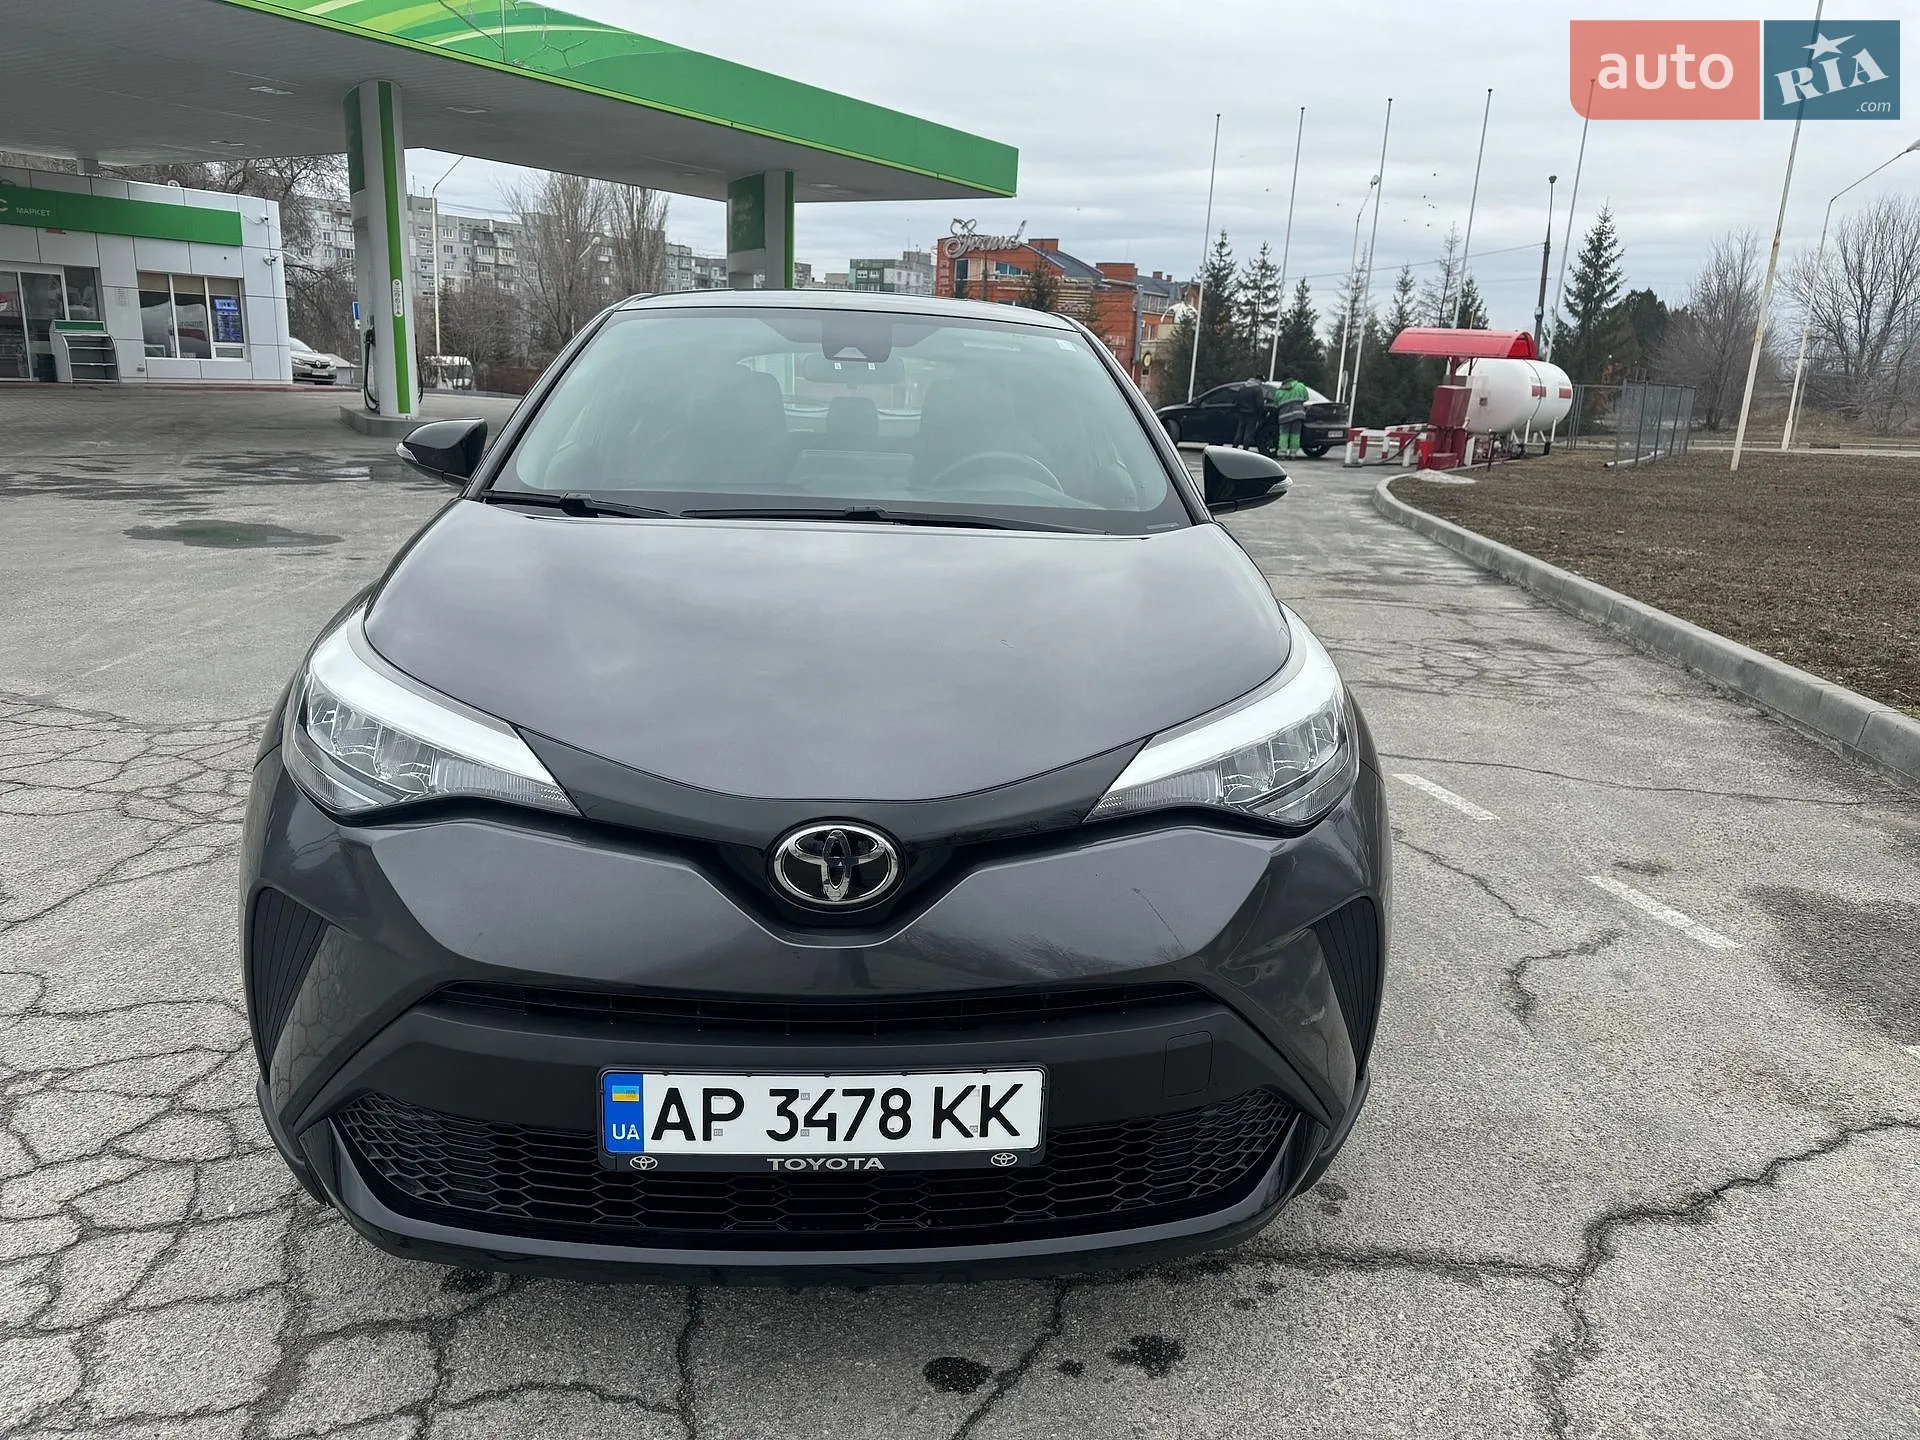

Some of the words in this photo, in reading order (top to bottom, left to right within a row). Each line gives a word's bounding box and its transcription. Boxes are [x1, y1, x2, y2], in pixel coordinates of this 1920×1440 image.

[650, 1086, 745, 1142] AP
[765, 1087, 913, 1142] 3478
[931, 1083, 1024, 1140] KK
[612, 1123, 640, 1141] UA
[766, 1156, 886, 1172] TOYOTA
